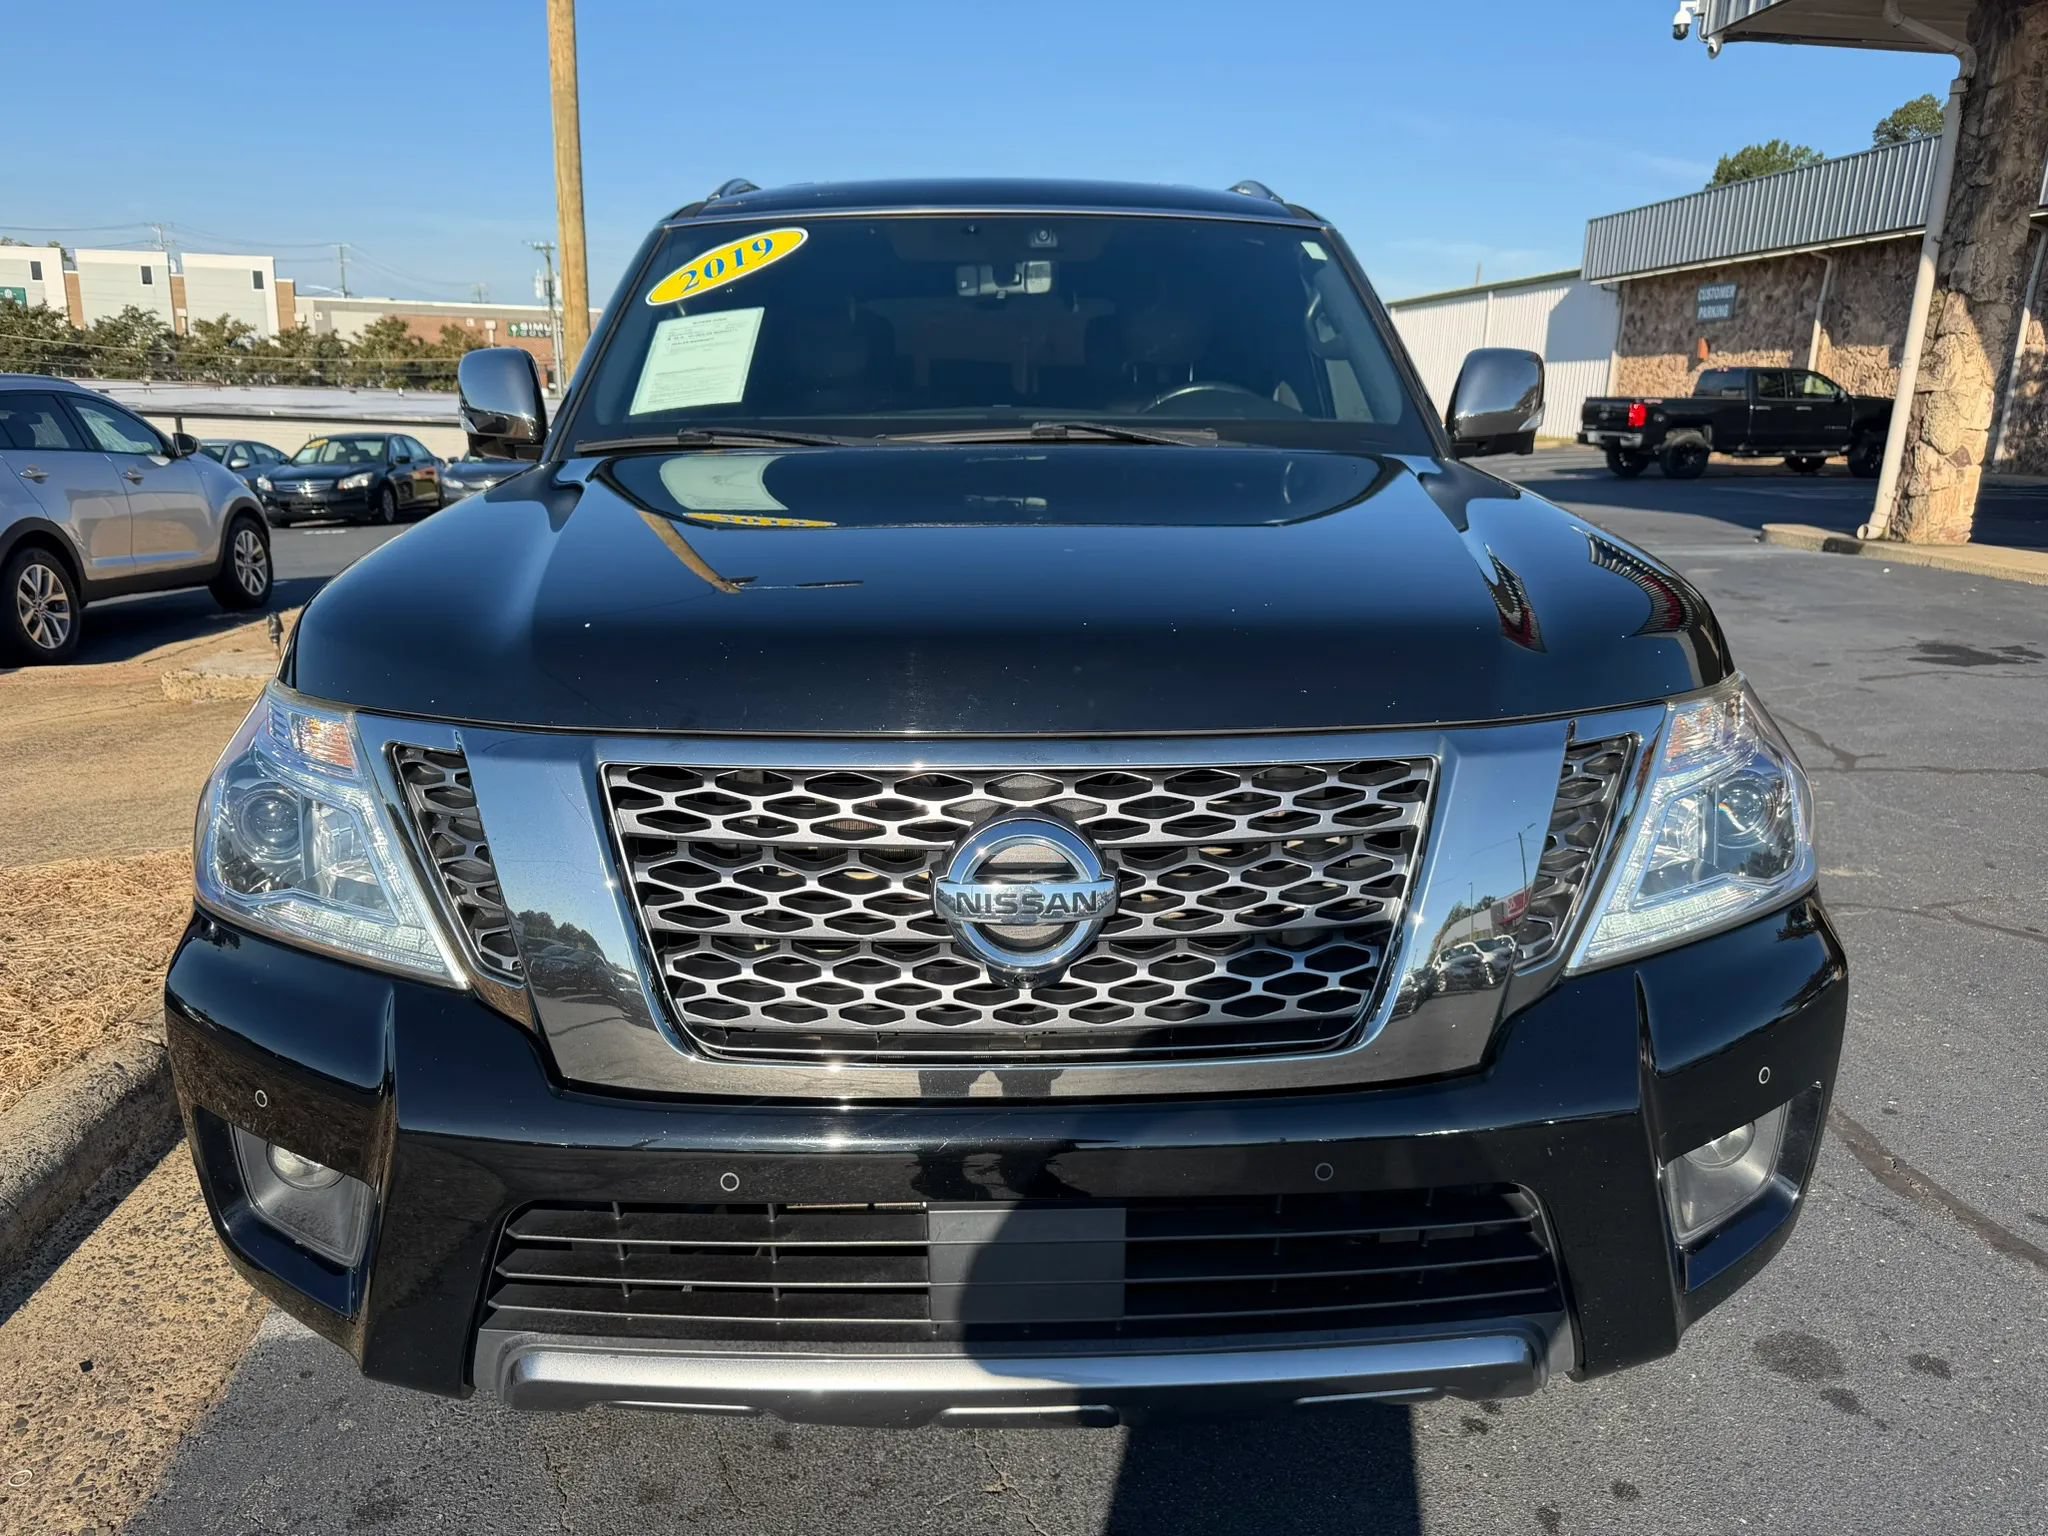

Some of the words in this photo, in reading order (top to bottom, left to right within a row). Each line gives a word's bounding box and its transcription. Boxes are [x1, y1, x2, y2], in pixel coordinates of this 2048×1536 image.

[679, 237, 774, 293] 2019
[1697, 284, 1737, 302] CUSTOMER
[1697, 304, 1729, 319] PARKING
[955, 890, 1098, 915] NISSAN
